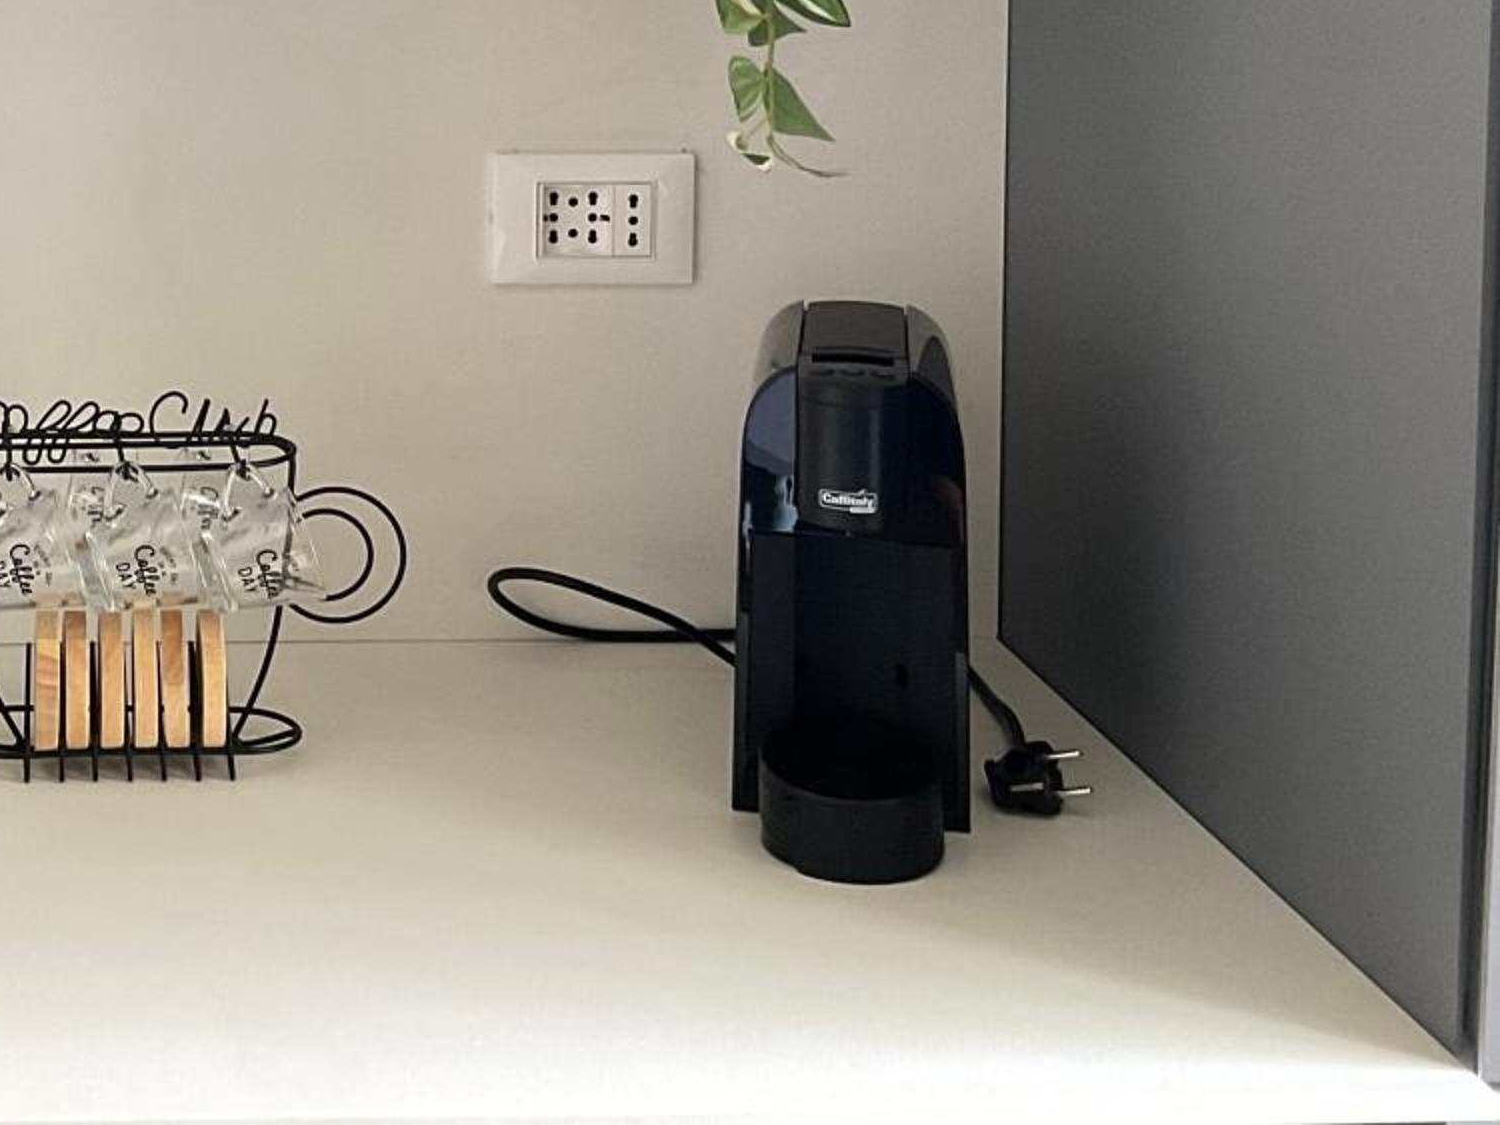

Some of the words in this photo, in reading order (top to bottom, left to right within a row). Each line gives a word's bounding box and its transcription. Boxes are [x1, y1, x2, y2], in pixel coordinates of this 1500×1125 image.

[149, 390, 277, 449] Club
[6, 542, 35, 596] Coffee
[115, 561, 136, 590] DAY
[131, 543, 161, 596] Coffee
[237, 566, 257, 592] DAY
